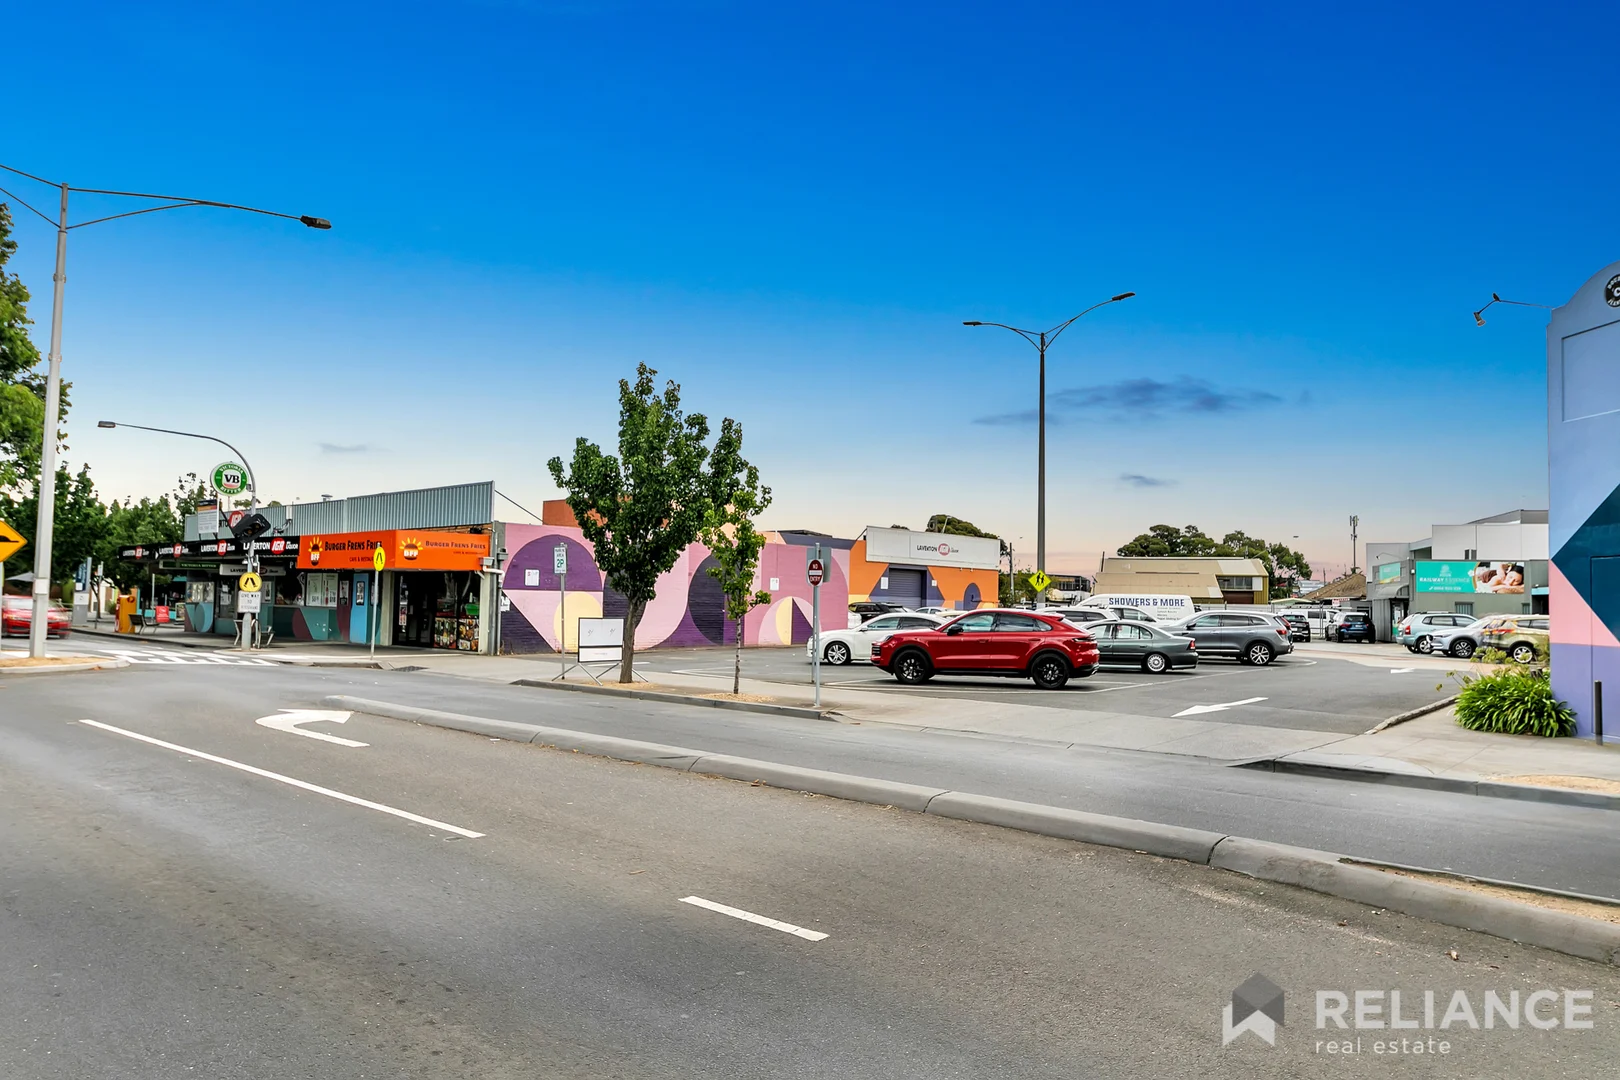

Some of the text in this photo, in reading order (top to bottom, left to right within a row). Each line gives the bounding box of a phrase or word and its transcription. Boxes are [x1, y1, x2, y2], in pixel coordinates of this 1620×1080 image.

[224, 474, 240, 483] VB
[243, 541, 271, 550] LAERTON
[271, 541, 285, 552] IGA
[325, 541, 346, 551] BURGER
[347, 540, 365, 550] FRENS
[425, 540, 449, 548] BURGER
[451, 541, 469, 549] FRENS
[556, 558, 565, 568] 2P
[1108, 597, 1185, 607] SHOWERS & MORE
